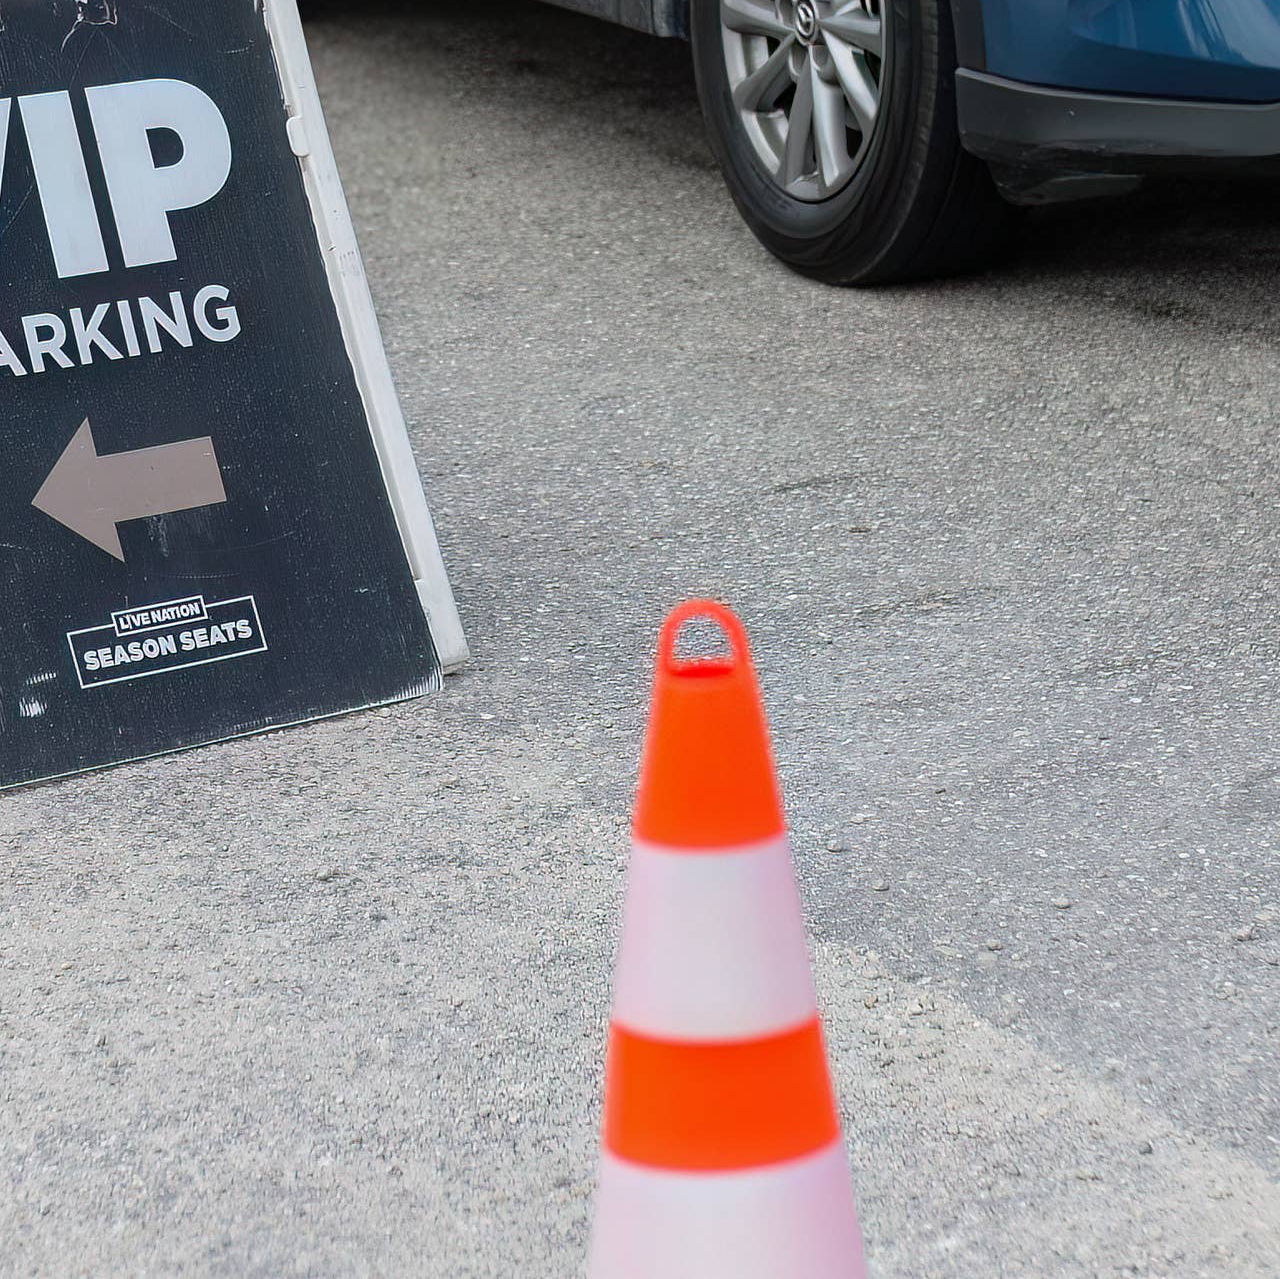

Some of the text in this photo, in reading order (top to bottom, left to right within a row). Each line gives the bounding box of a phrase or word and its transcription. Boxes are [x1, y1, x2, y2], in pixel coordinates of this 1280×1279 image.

[118, 602, 201, 630] LIVE NATION
[84, 619, 253, 671] SEASON SEATS
